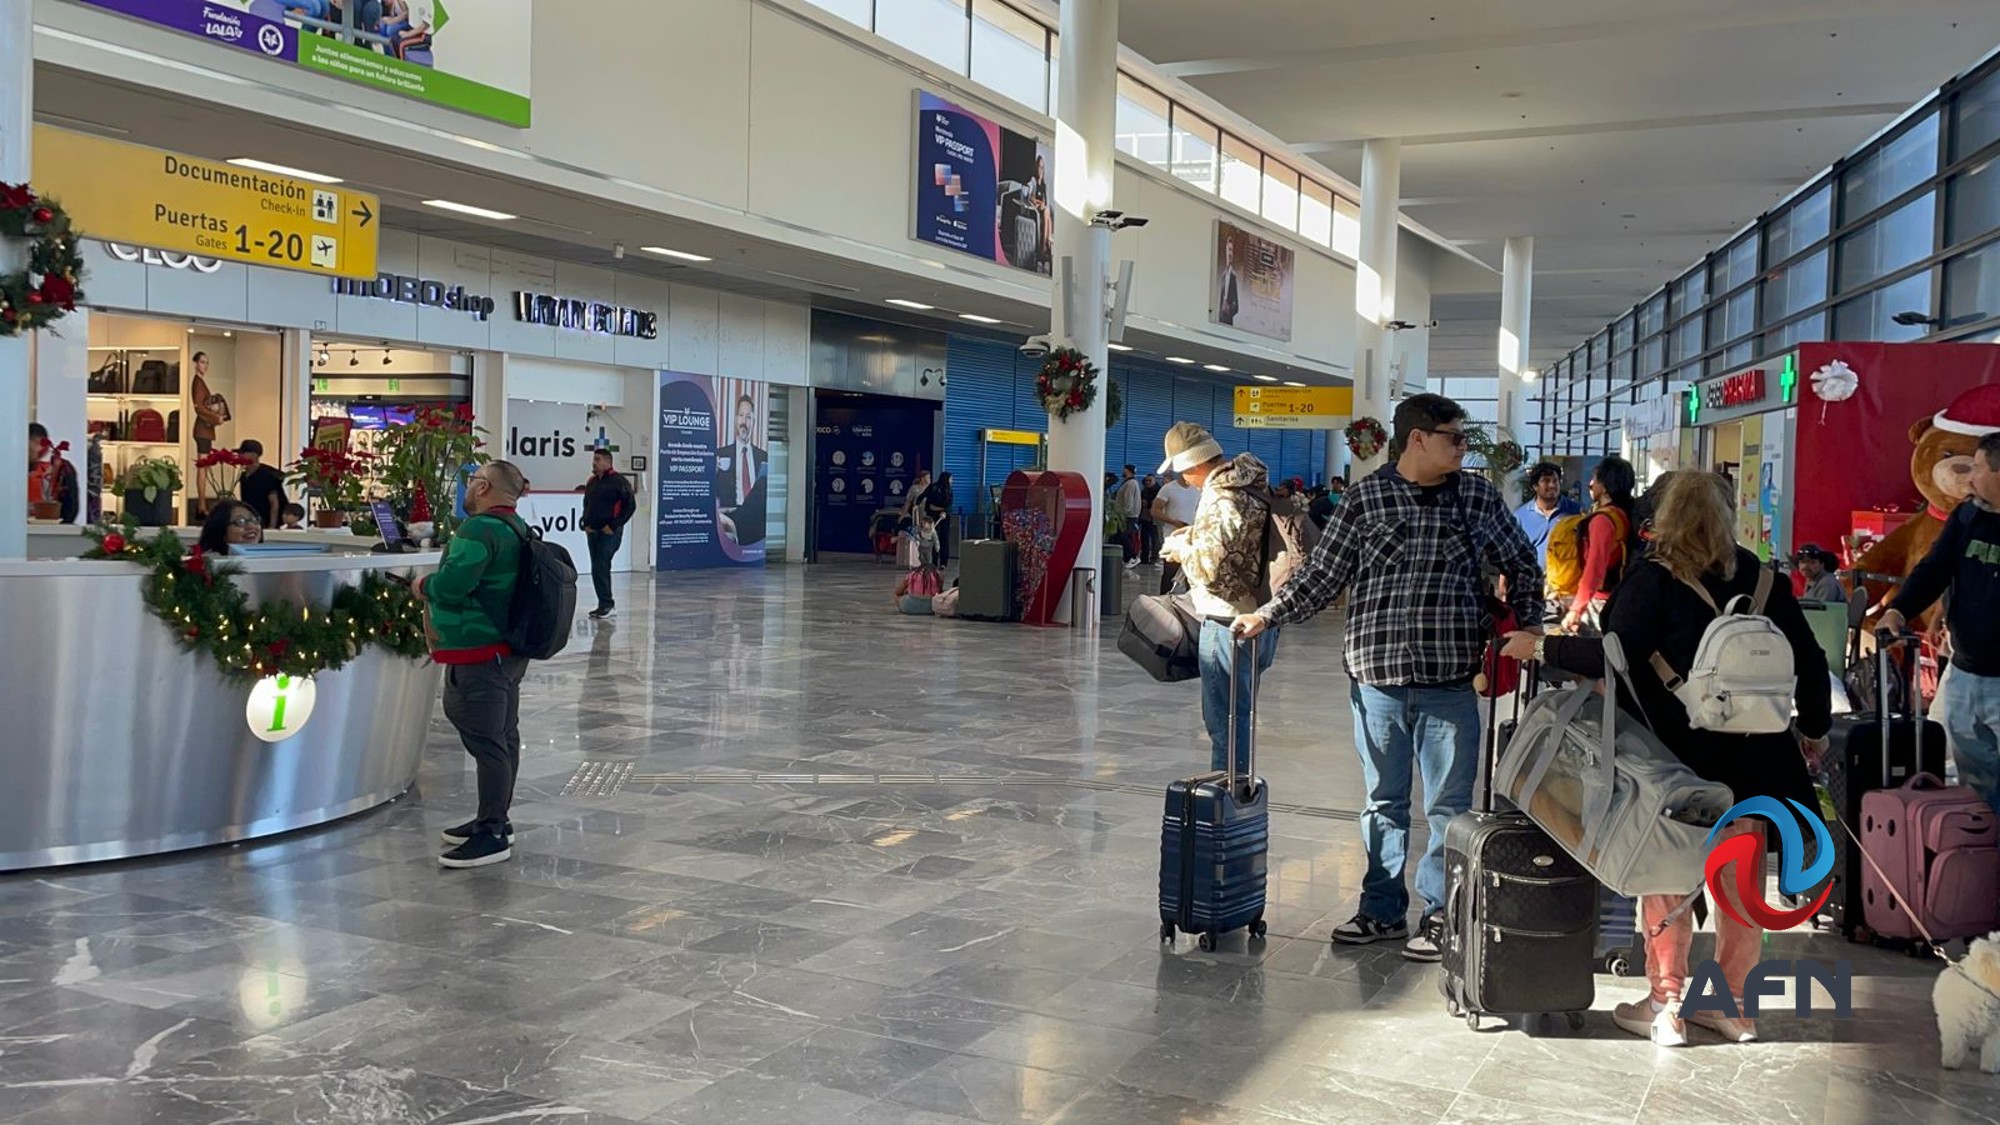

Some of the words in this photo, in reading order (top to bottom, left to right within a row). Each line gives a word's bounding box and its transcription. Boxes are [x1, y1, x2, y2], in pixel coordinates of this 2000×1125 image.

[165, 156, 306, 200] Documentación
[155, 203, 228, 233] Puertas
[235, 225, 303, 262] 1-20
[196, 234, 227, 250] Gates
[1288, 403, 1314, 413] 1-20
[663, 414, 677, 425] VIP
[678, 415, 710, 427] LOUNGE
[506, 427, 576, 457] laris
